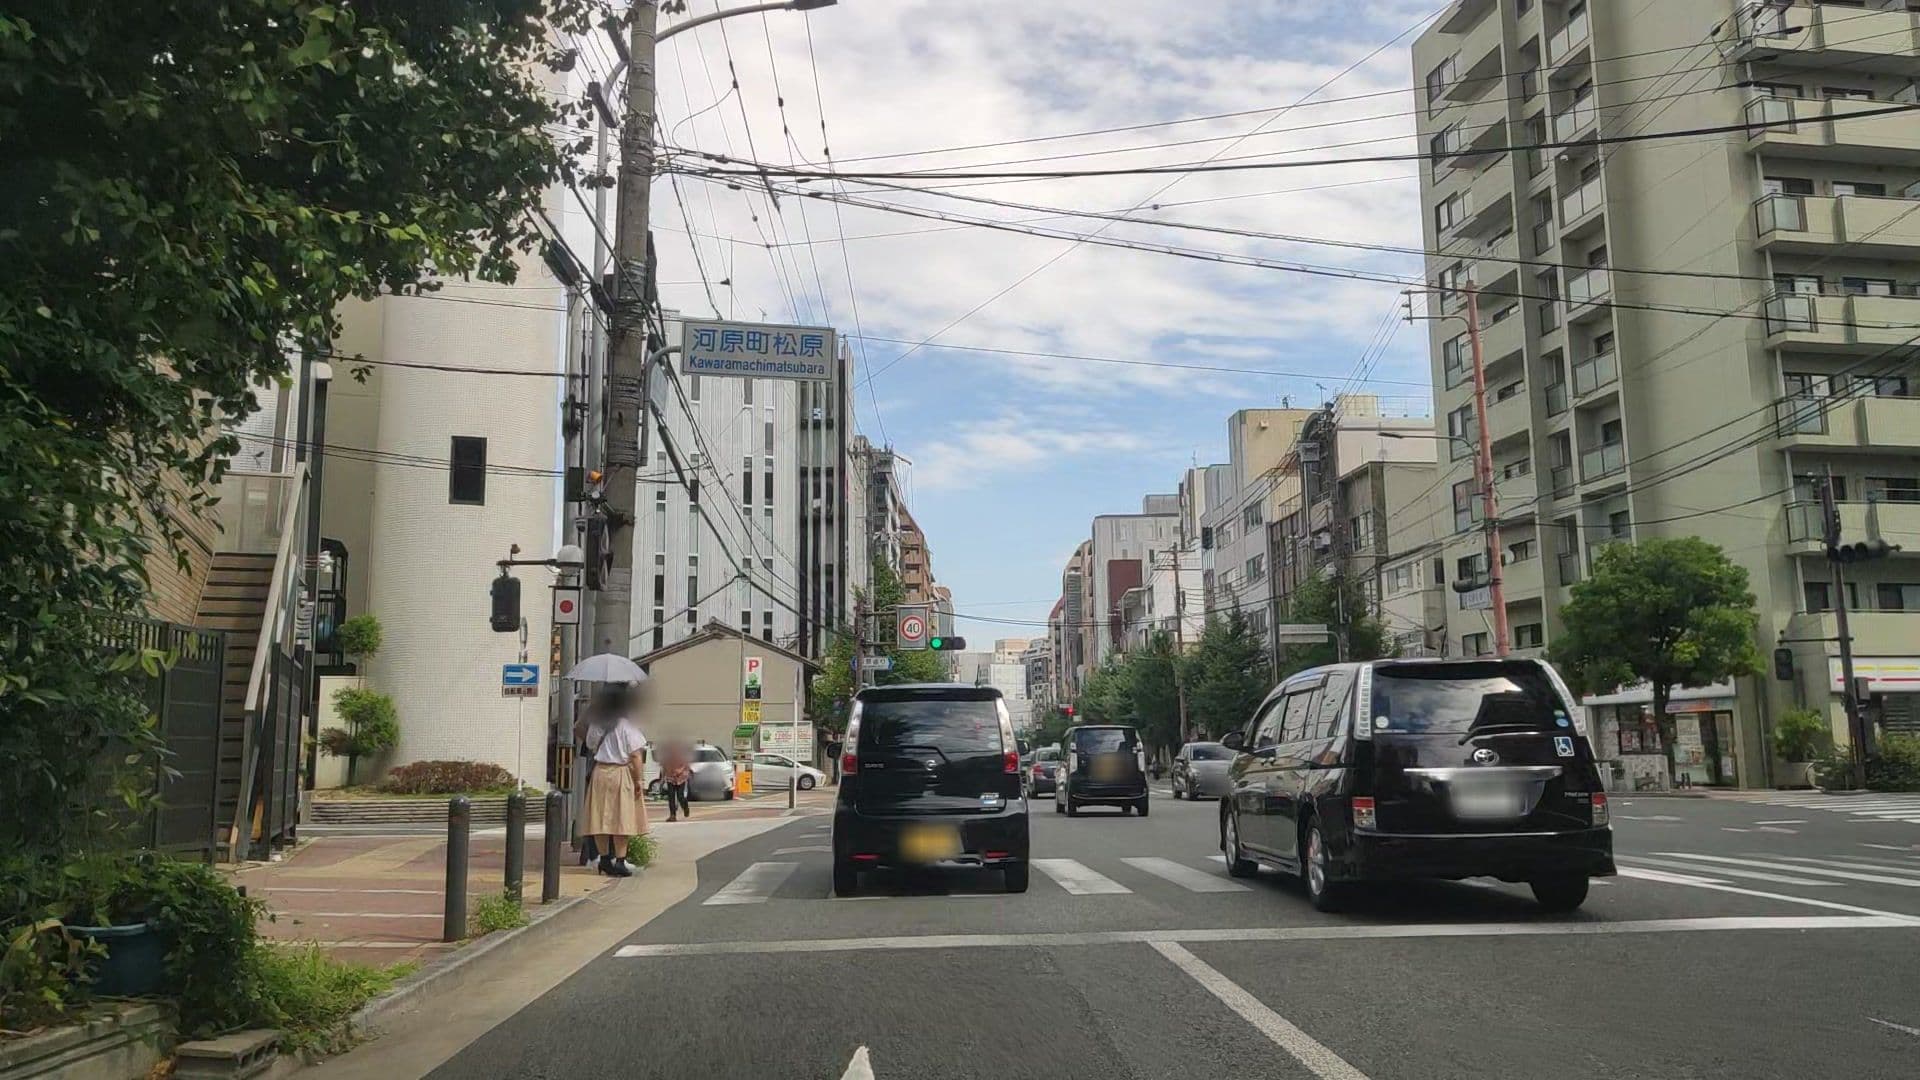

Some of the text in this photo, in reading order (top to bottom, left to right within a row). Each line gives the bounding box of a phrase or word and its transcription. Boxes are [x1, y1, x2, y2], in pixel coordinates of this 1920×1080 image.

[692, 328, 824, 358] 河原町松原
[689, 355, 825, 375] Kawaramachimatsubara
[906, 622, 920, 634] 40
[748, 659, 759, 673] P
